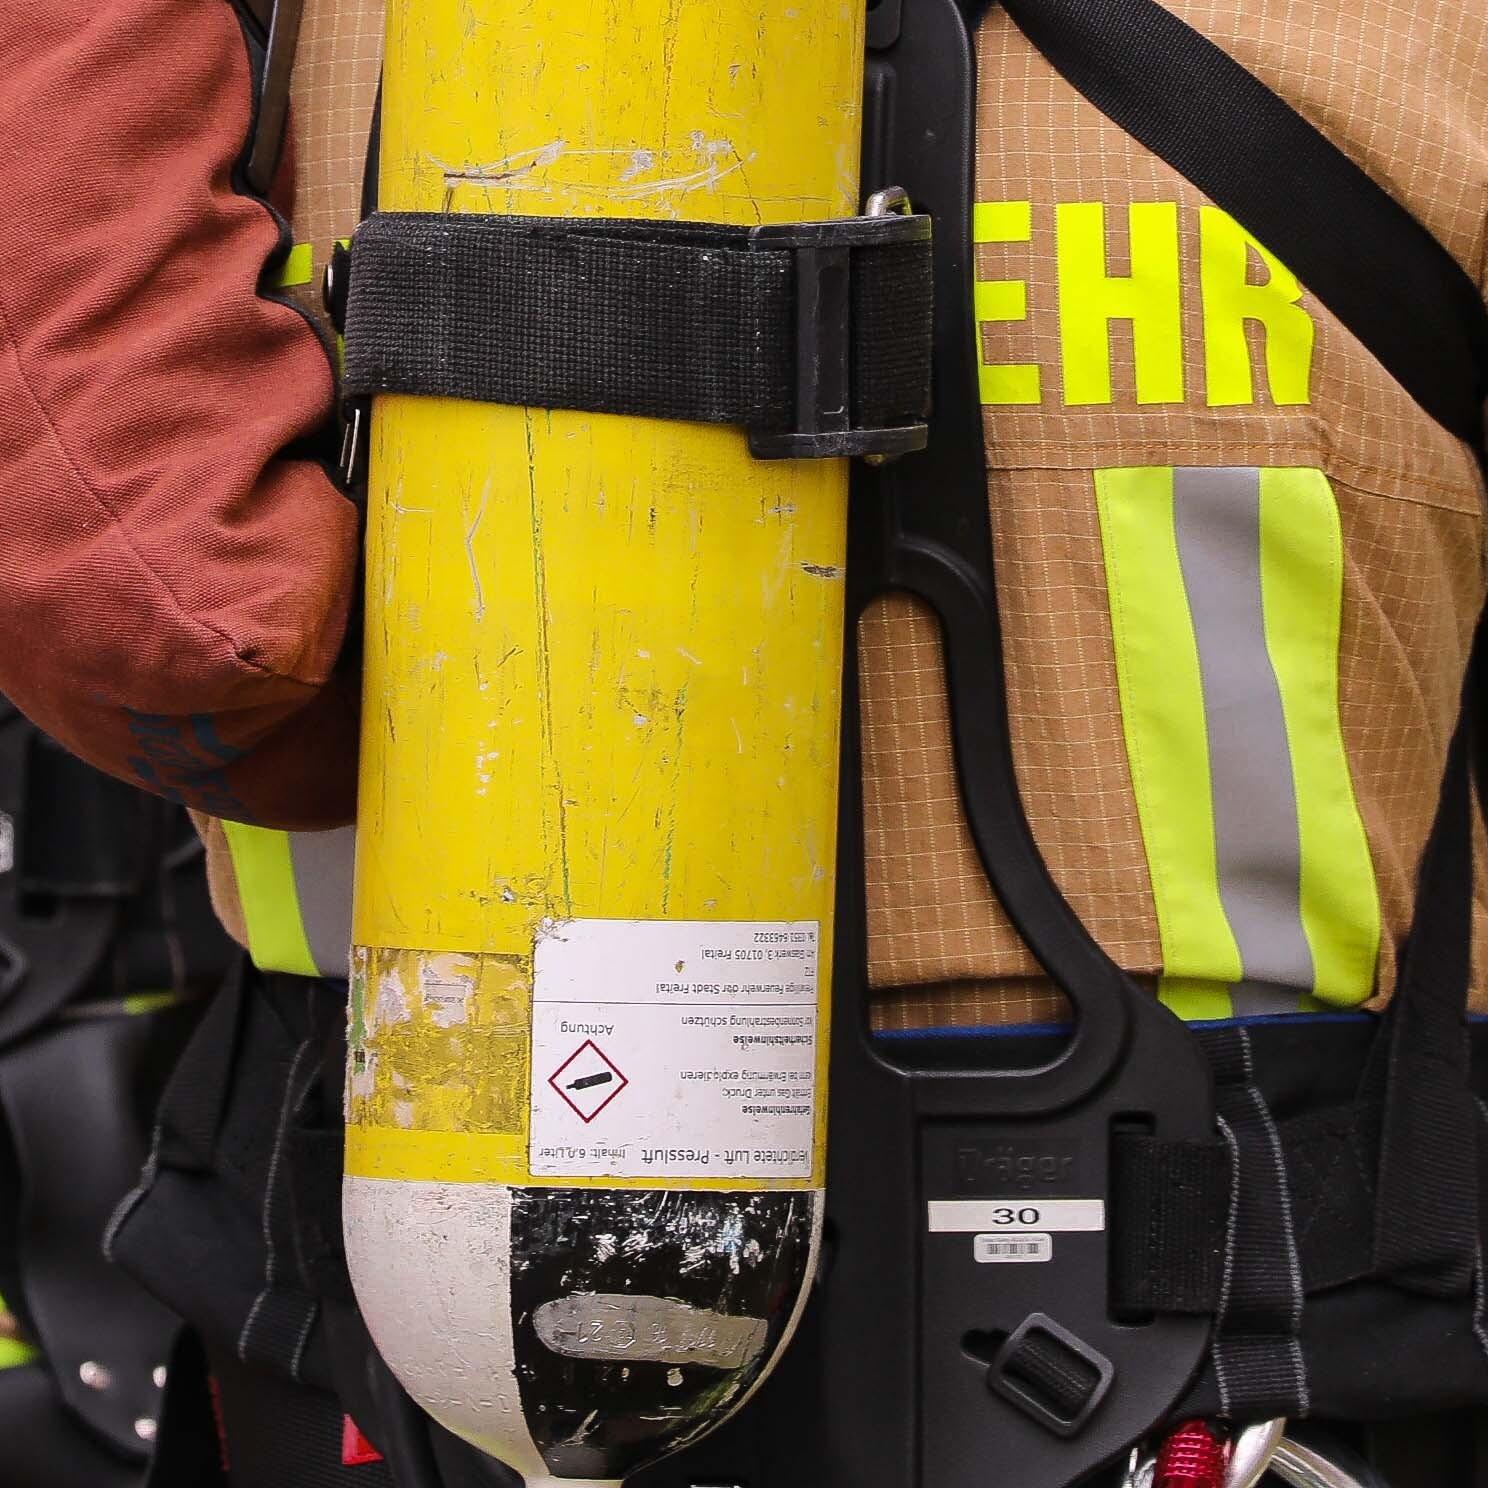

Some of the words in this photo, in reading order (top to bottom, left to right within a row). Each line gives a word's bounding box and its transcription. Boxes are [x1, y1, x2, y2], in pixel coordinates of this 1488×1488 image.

[974, 201, 1314, 406] EHR
[701, 950, 732, 960] Freital
[656, 984, 689, 994] Freital
[692, 984, 720, 994] Stadt
[560, 1021, 615, 1036] Achtung
[681, 1017, 728, 1027] schützen
[641, 1149, 709, 1165] Pressluft
[724, 1150, 750, 1164] Luft
[992, 1208, 1040, 1224] 30
